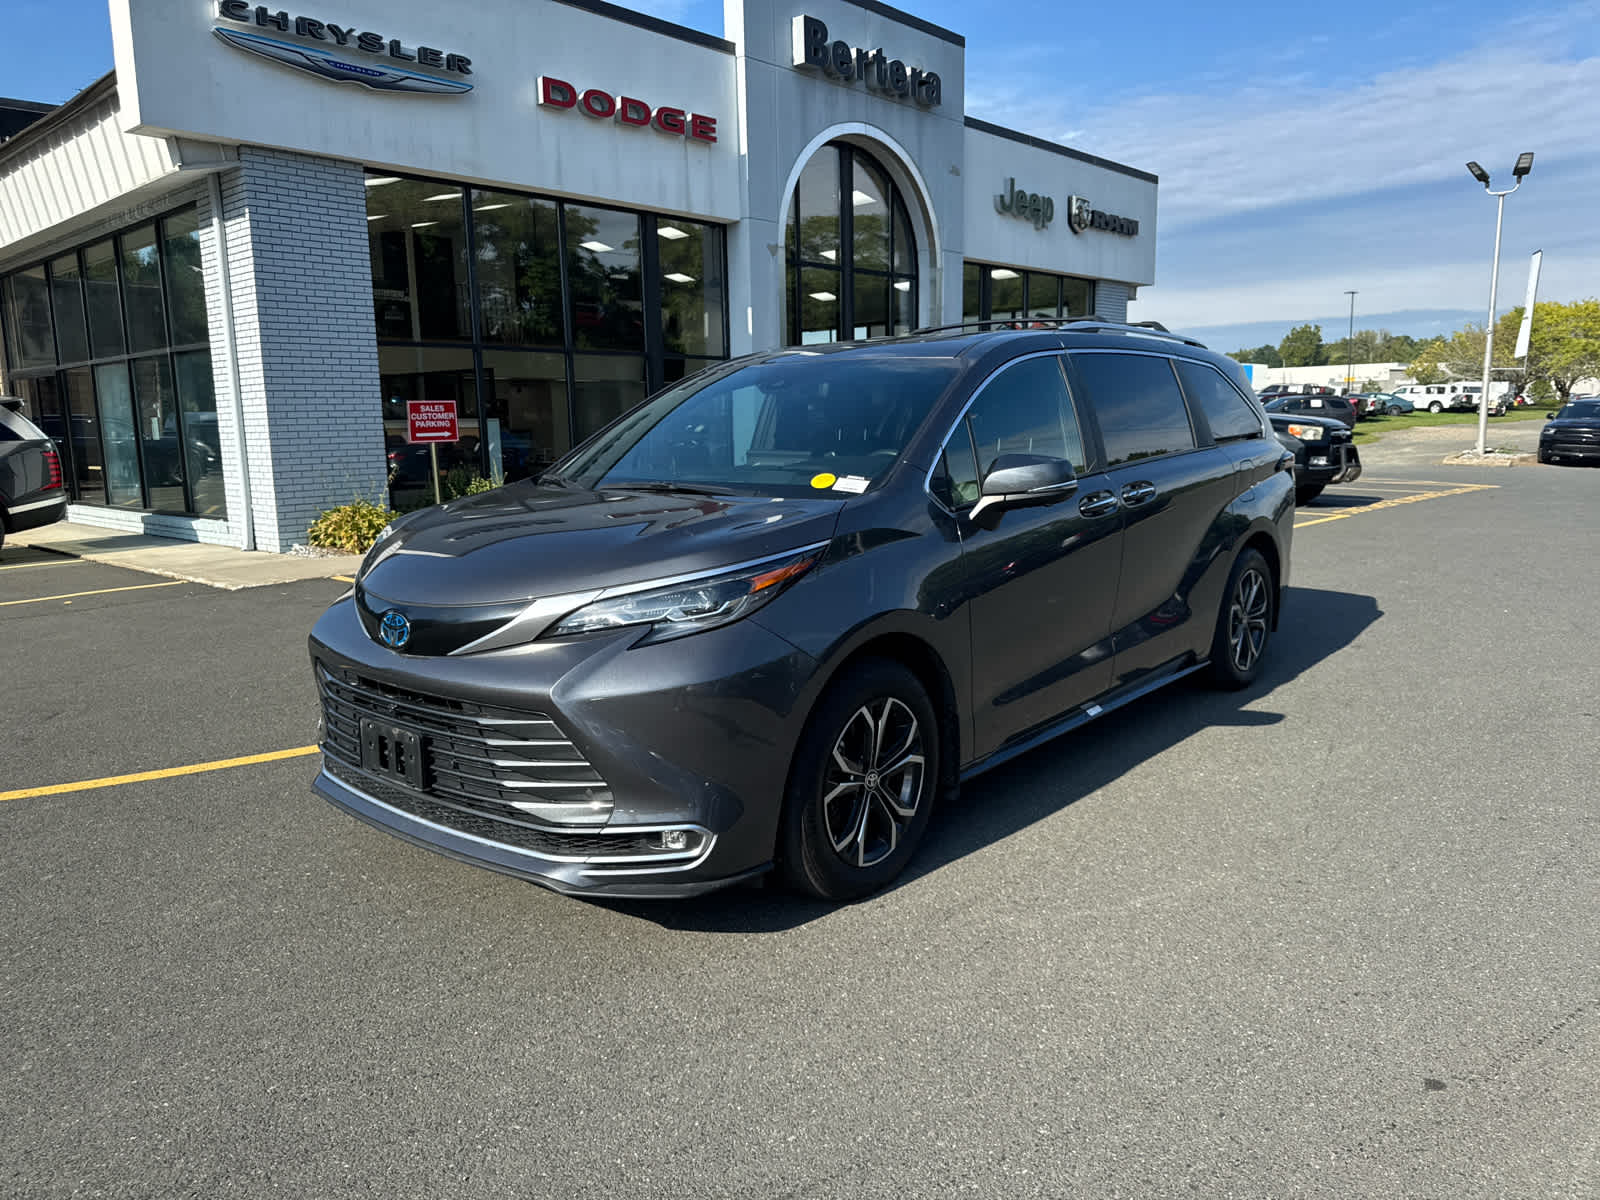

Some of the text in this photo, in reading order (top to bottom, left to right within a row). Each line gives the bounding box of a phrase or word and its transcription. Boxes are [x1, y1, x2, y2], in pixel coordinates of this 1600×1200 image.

[217, 0, 473, 75] CHRYSLER
[793, 14, 942, 106] Bertera
[537, 76, 718, 144] DODGE
[994, 177, 1055, 231] Jeep
[1089, 209, 1140, 236] RAM
[411, 412, 455, 420] CUSTOMER
[415, 420, 451, 428] PARKING
[420, 404, 445, 412] SALES
